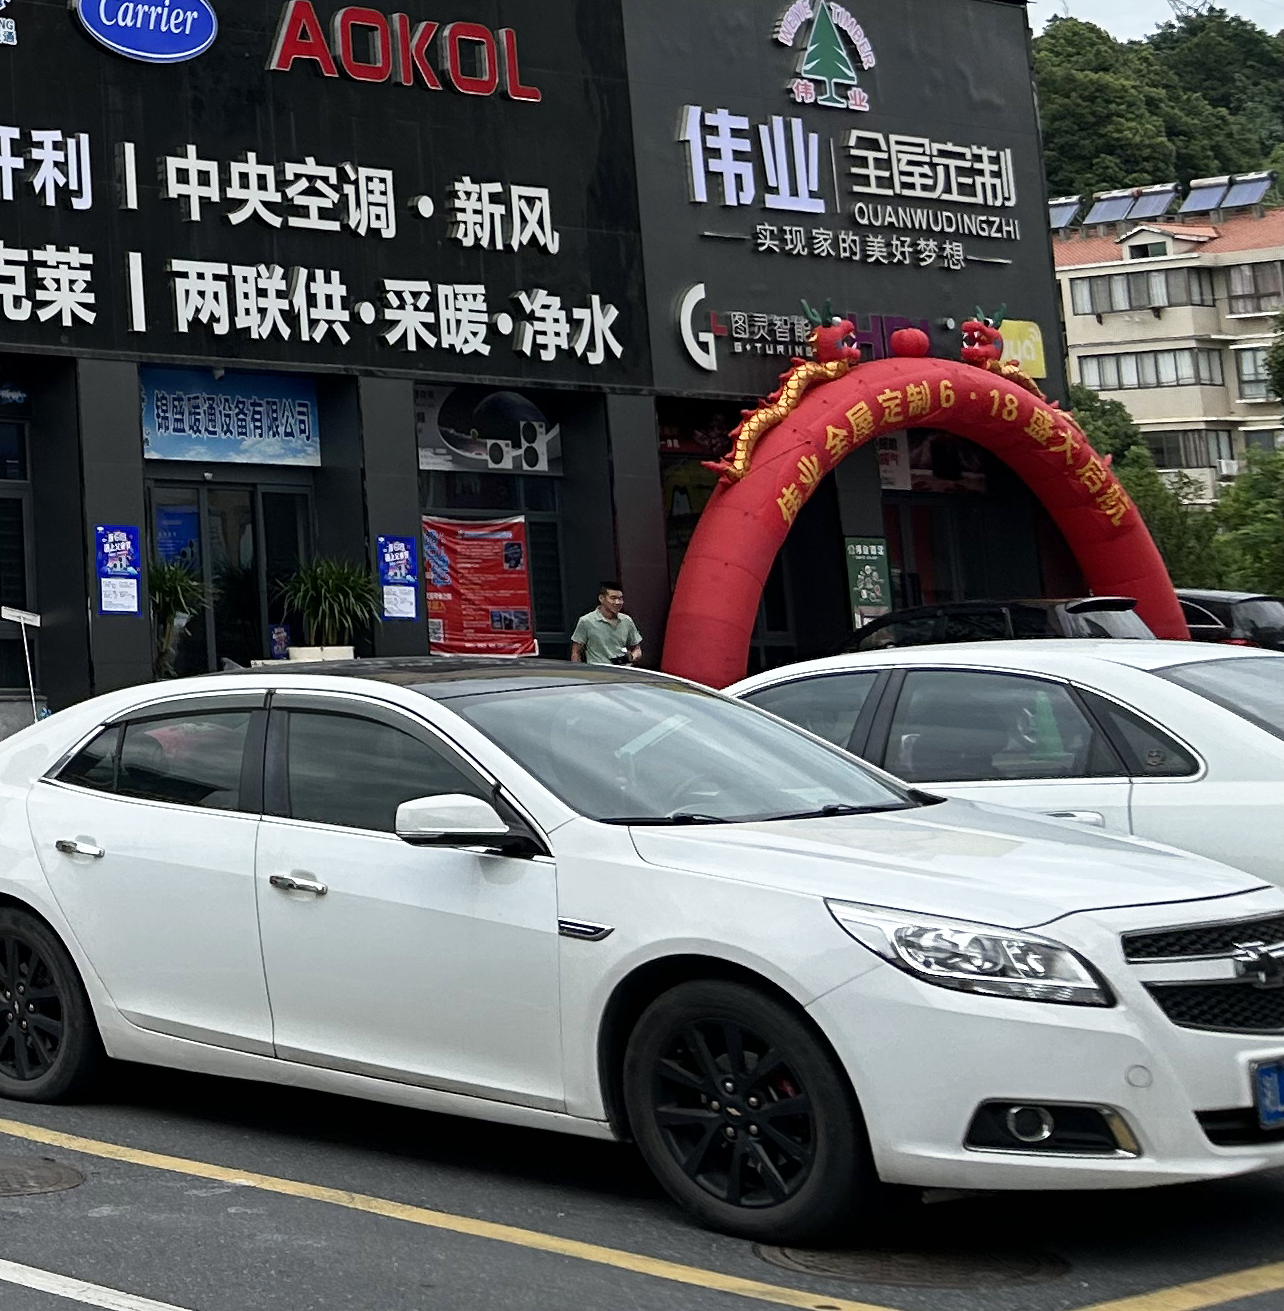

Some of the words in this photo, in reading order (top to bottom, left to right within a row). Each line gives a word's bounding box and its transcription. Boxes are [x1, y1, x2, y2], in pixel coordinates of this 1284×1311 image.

[830, 1, 876, 71] TIMBER
[680, 105, 826, 214] 伟业
[844, 128, 1017, 207] 全屋定制
[755, 222, 966, 270] 实现家的美好梦想
[854, 201, 1022, 241] QUANWUDINGZHI
[153, 390, 312, 442] 锦盛暖通设备有限公司
